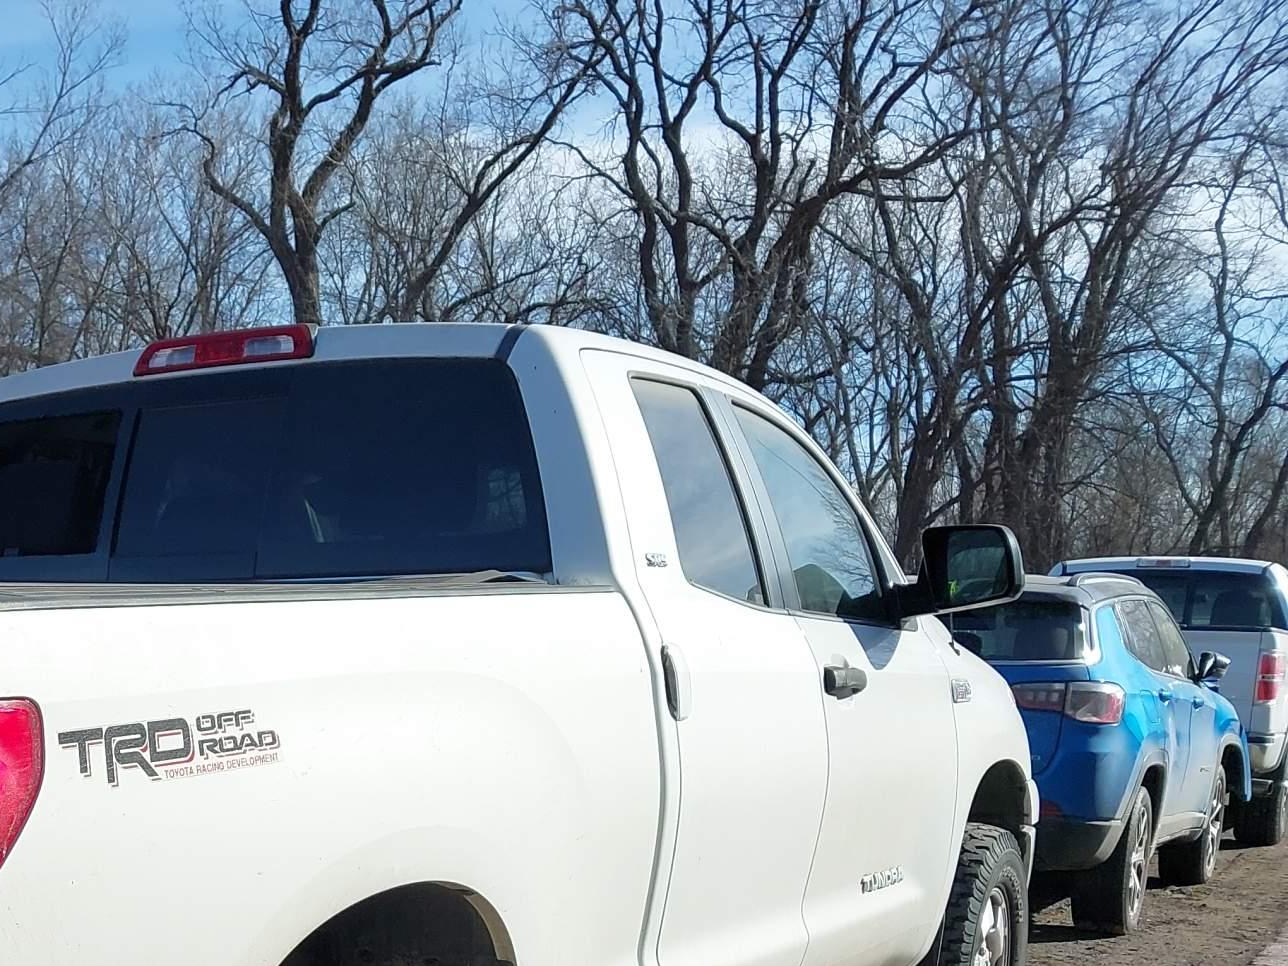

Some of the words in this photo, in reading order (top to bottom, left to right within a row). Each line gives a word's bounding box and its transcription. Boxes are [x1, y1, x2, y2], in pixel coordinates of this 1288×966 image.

[196, 709, 255, 735] OFF
[58, 718, 194, 787] TRD
[198, 730, 280, 760] ROAD
[164, 766, 194, 779] TOYOTA
[196, 761, 225, 775] RACING
[227, 753, 279, 769] DEVELOPMENT
[860, 866, 904, 894] TUNDRA
